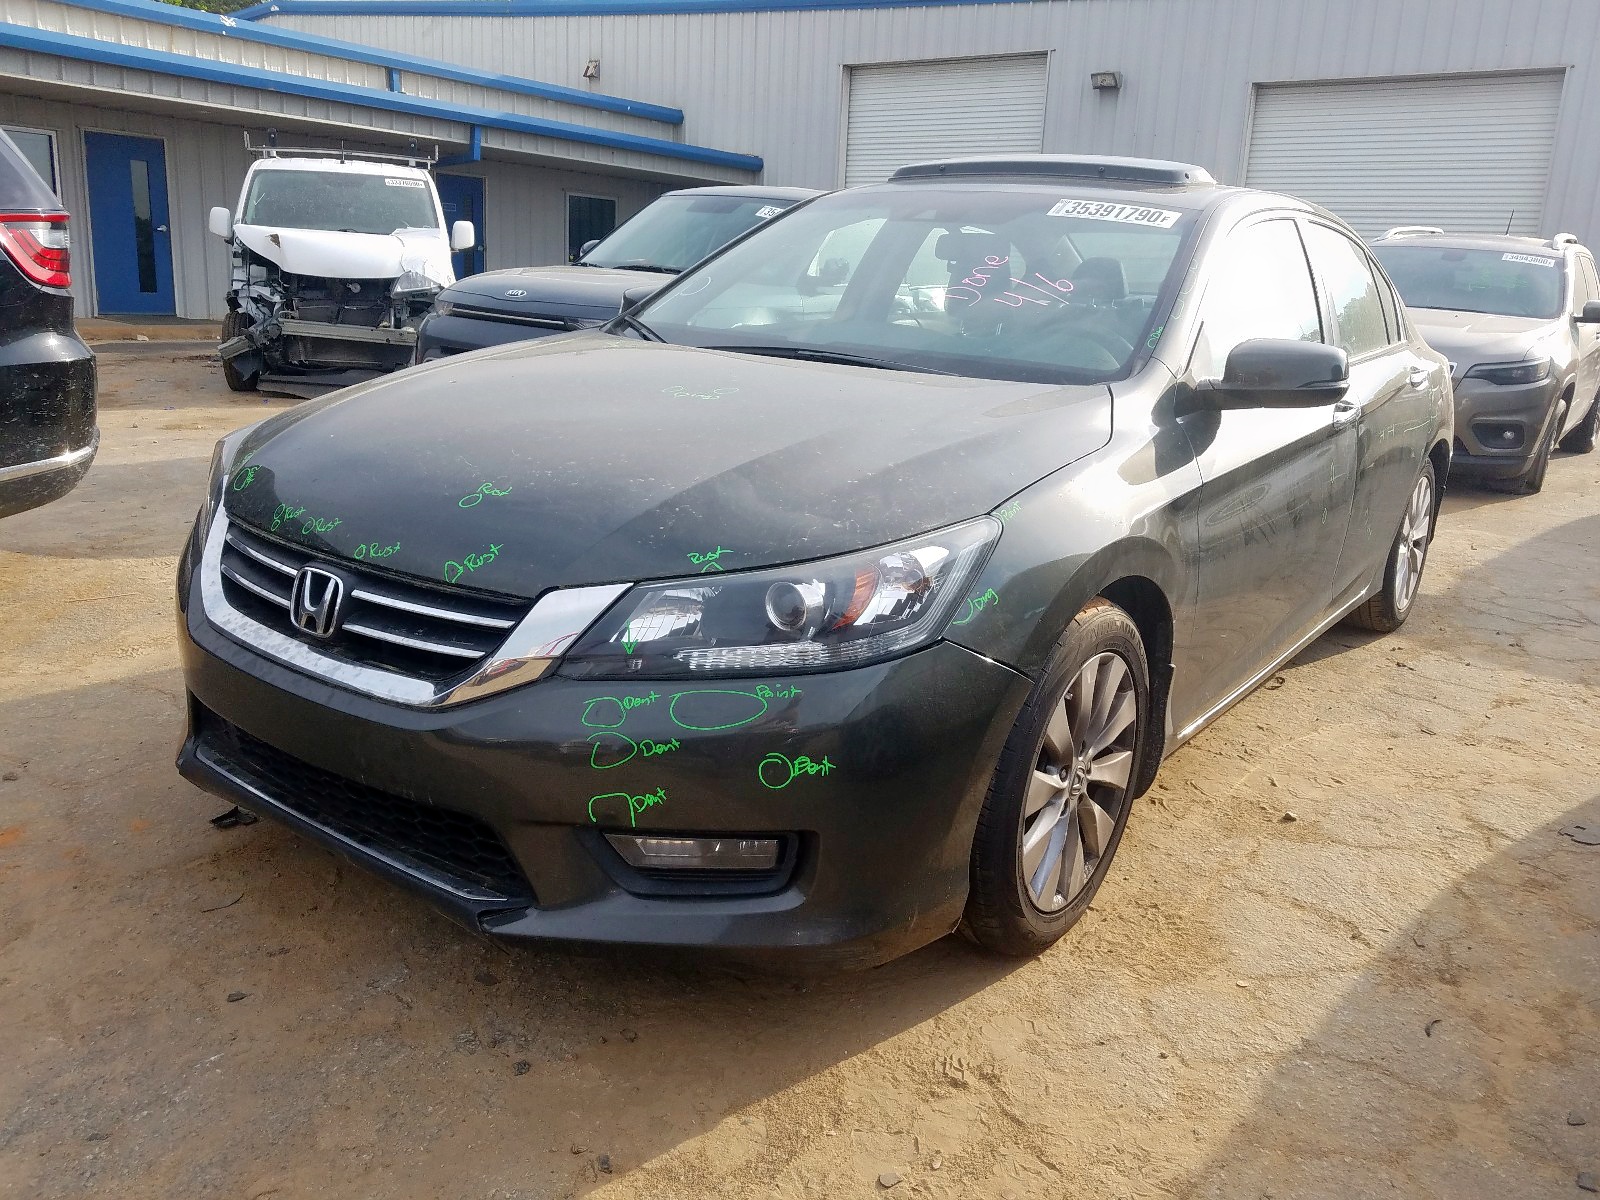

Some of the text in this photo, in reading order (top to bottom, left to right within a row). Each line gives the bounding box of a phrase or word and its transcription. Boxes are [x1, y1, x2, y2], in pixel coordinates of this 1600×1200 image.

[944, 255, 1009, 307] Done
[314, 517, 343, 533] Rust
[369, 541, 401, 558] Rust
[463, 543, 504, 572] Rust
[623, 691, 661, 709] Dent
[755, 683, 802, 699] Paint
[640, 737, 681, 757] Dent
